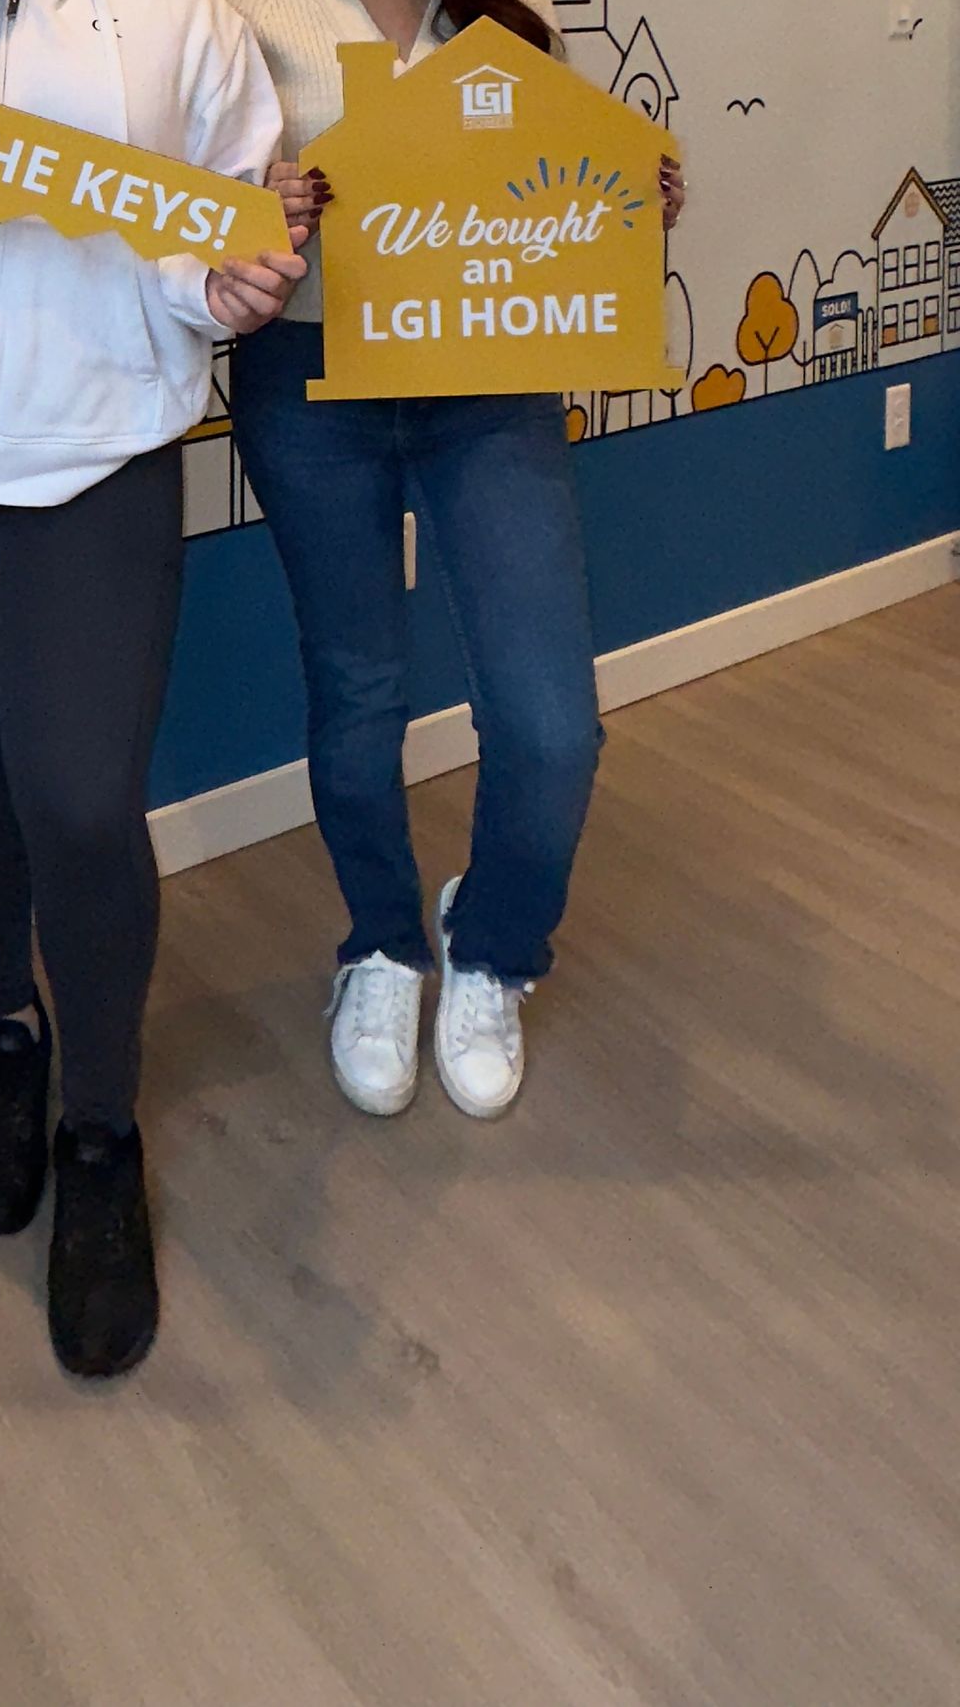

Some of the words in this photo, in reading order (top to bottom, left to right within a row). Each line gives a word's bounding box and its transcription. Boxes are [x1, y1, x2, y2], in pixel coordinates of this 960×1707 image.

[462, 82, 513, 115] LGI
[71, 161, 237, 251] KEYS!
[361, 201, 452, 256] We
[458, 200, 611, 263] bought
[462, 258, 513, 284] an
[363, 299, 441, 340] LGI
[461, 294, 618, 337] HOME
